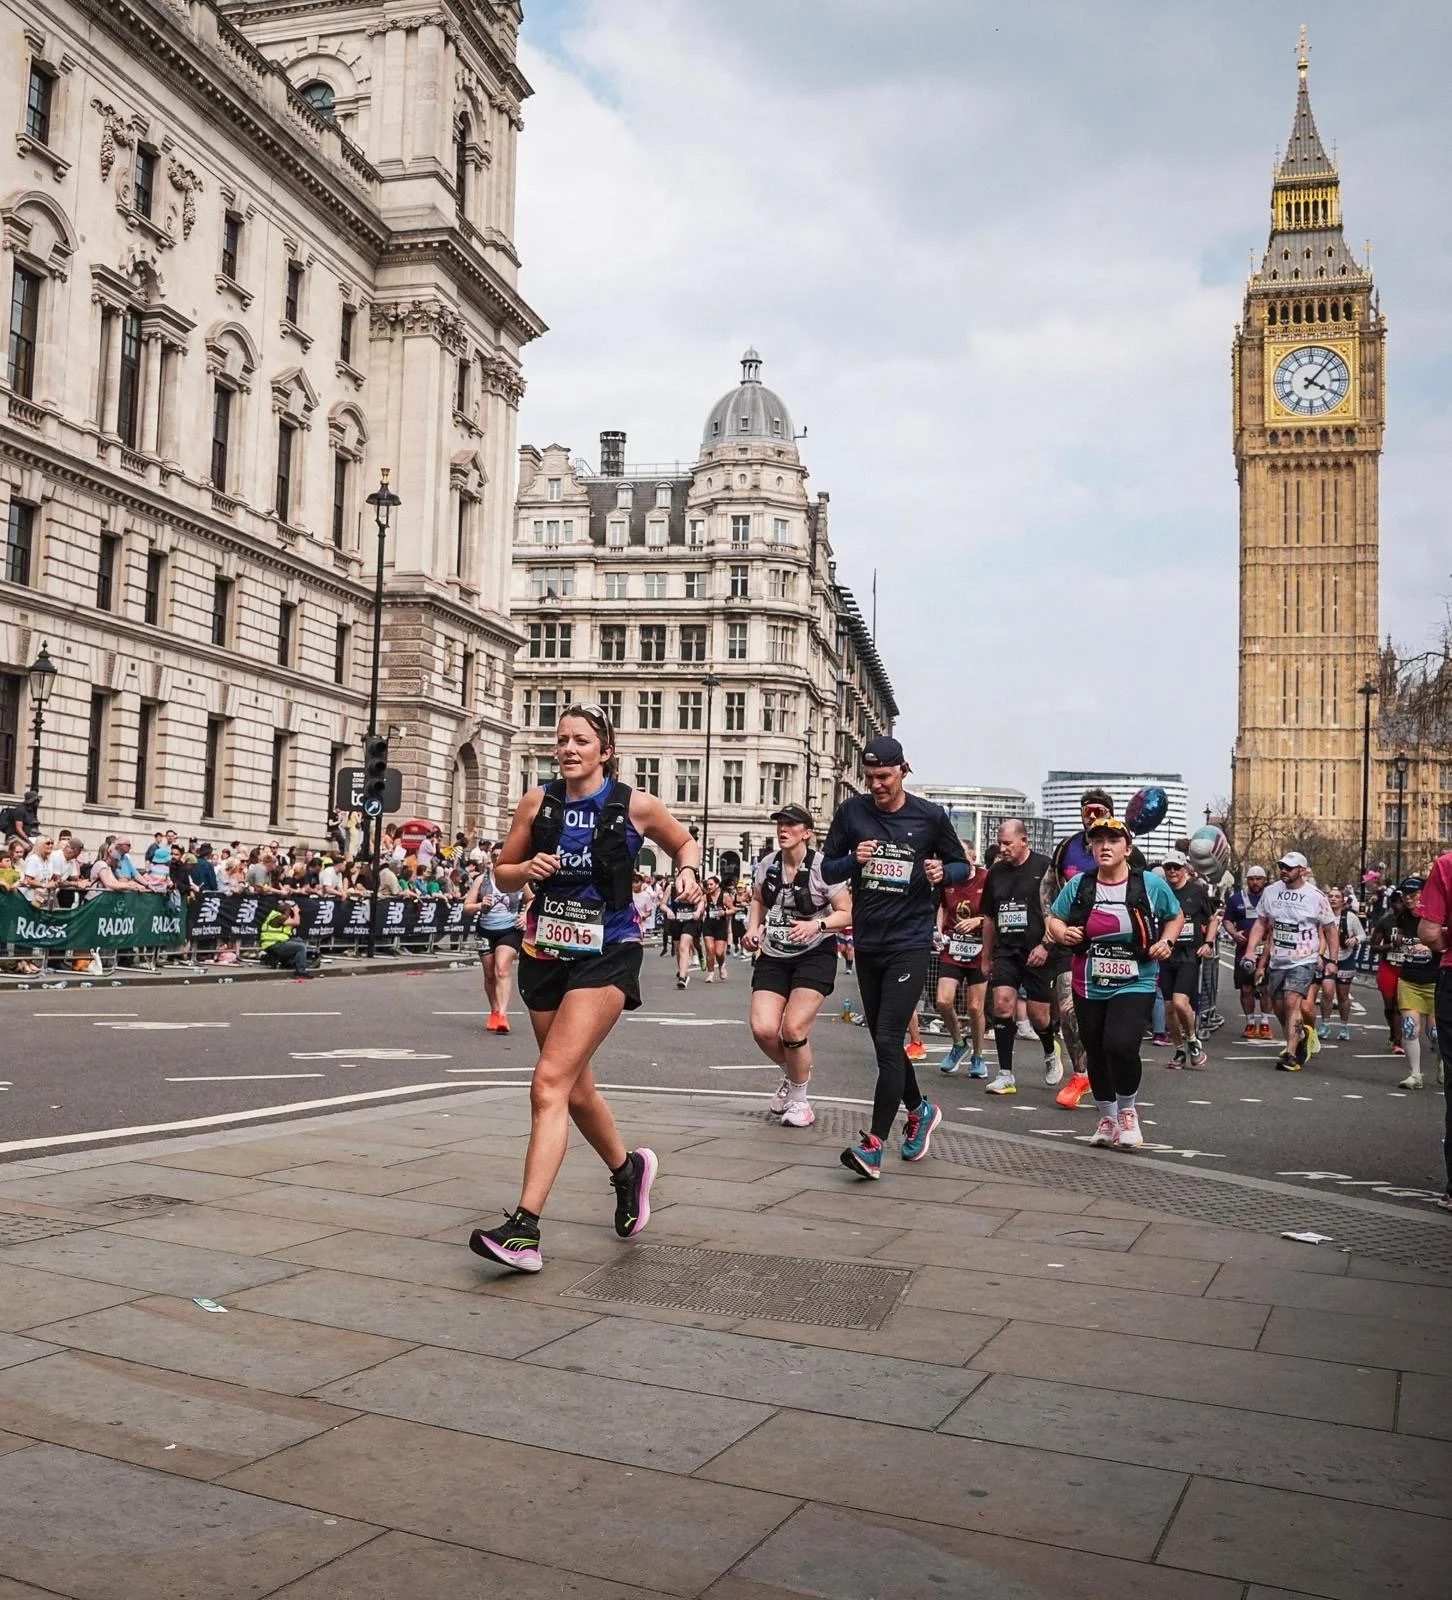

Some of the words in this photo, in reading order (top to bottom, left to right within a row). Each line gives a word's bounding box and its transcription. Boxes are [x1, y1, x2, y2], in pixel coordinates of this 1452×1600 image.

[351, 790, 364, 806] tc
[563, 810, 596, 828] OLL
[555, 845, 593, 867] trok
[870, 862, 903, 878] 29335
[544, 896, 565, 915] tcs
[1277, 891, 1306, 902] KODY
[565, 911, 587, 920] SERVICES
[16, 916, 68, 939] RADOX
[98, 916, 135, 937] RADOX
[545, 923, 592, 945] 36015
[1099, 962, 1131, 975] 33850
